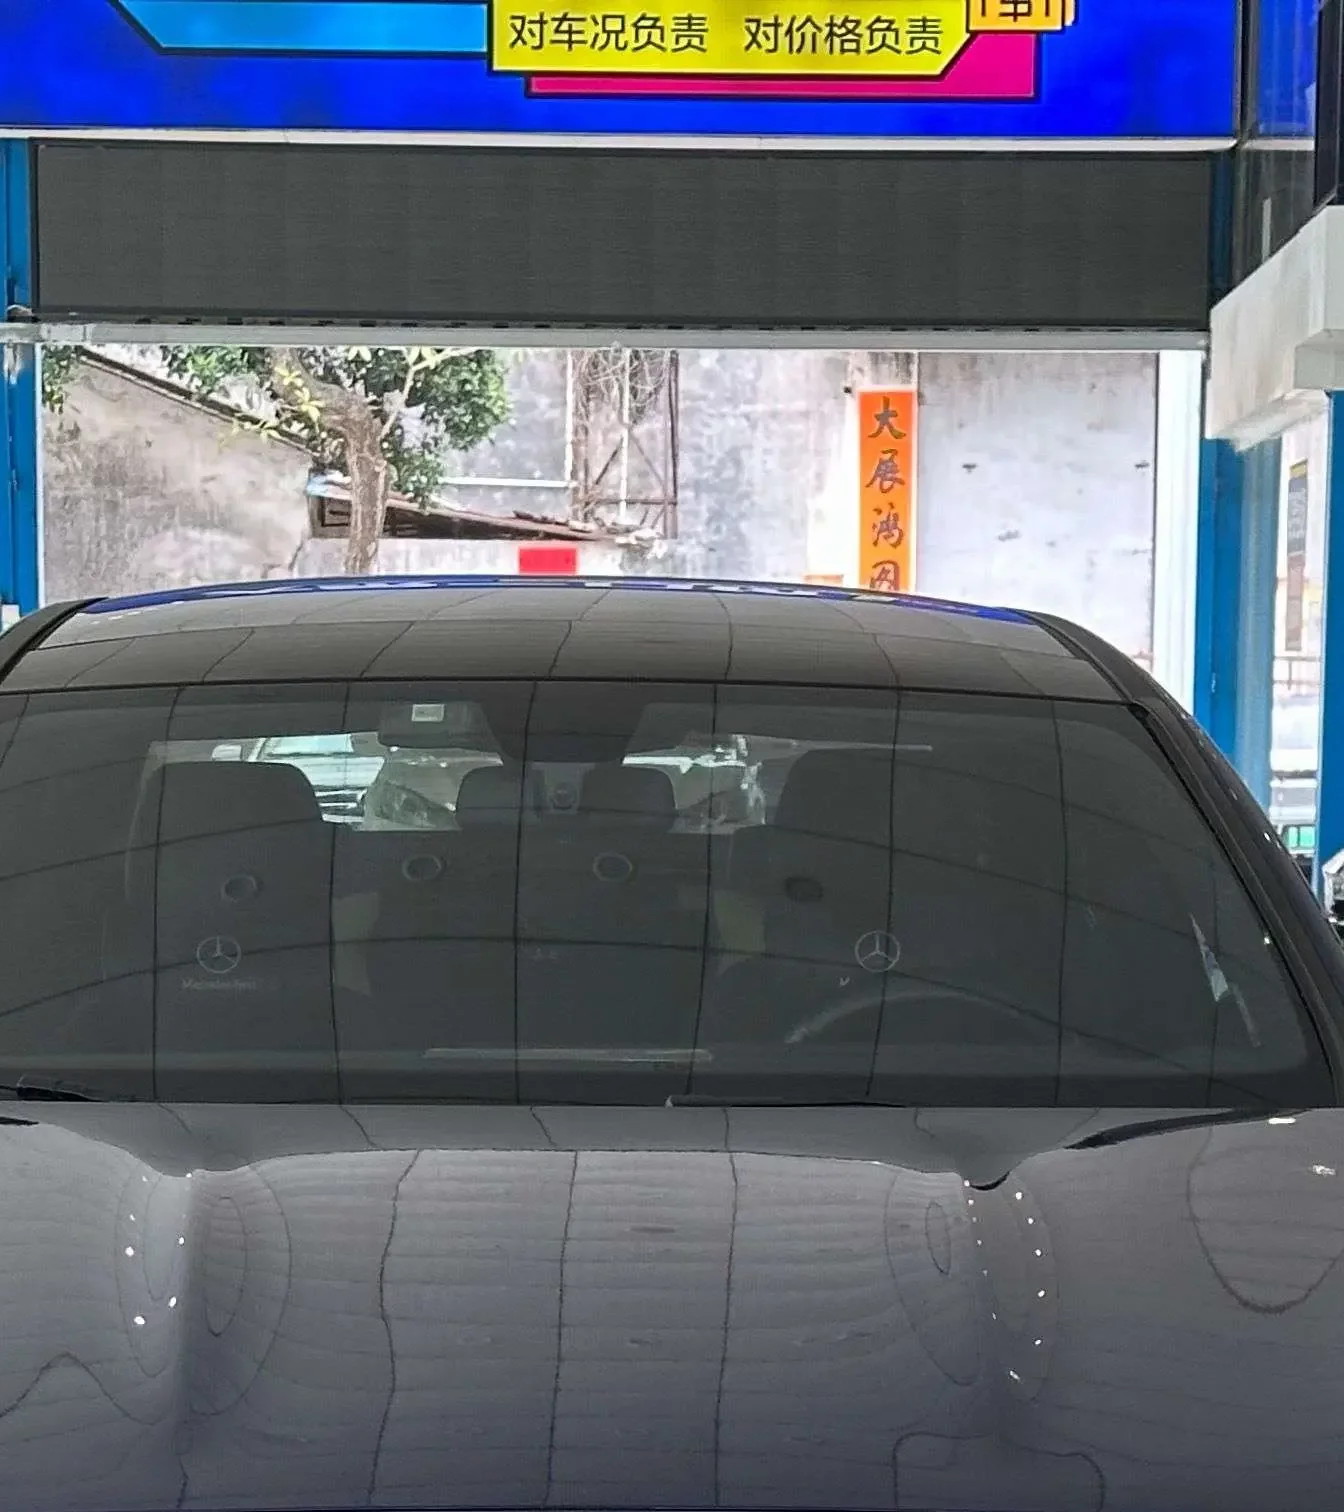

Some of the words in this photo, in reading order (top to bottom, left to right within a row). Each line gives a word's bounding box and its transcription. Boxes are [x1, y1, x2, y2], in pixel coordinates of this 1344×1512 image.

[509, 13, 709, 53] 对车况负责
[744, 14, 945, 56] 对价格负责
